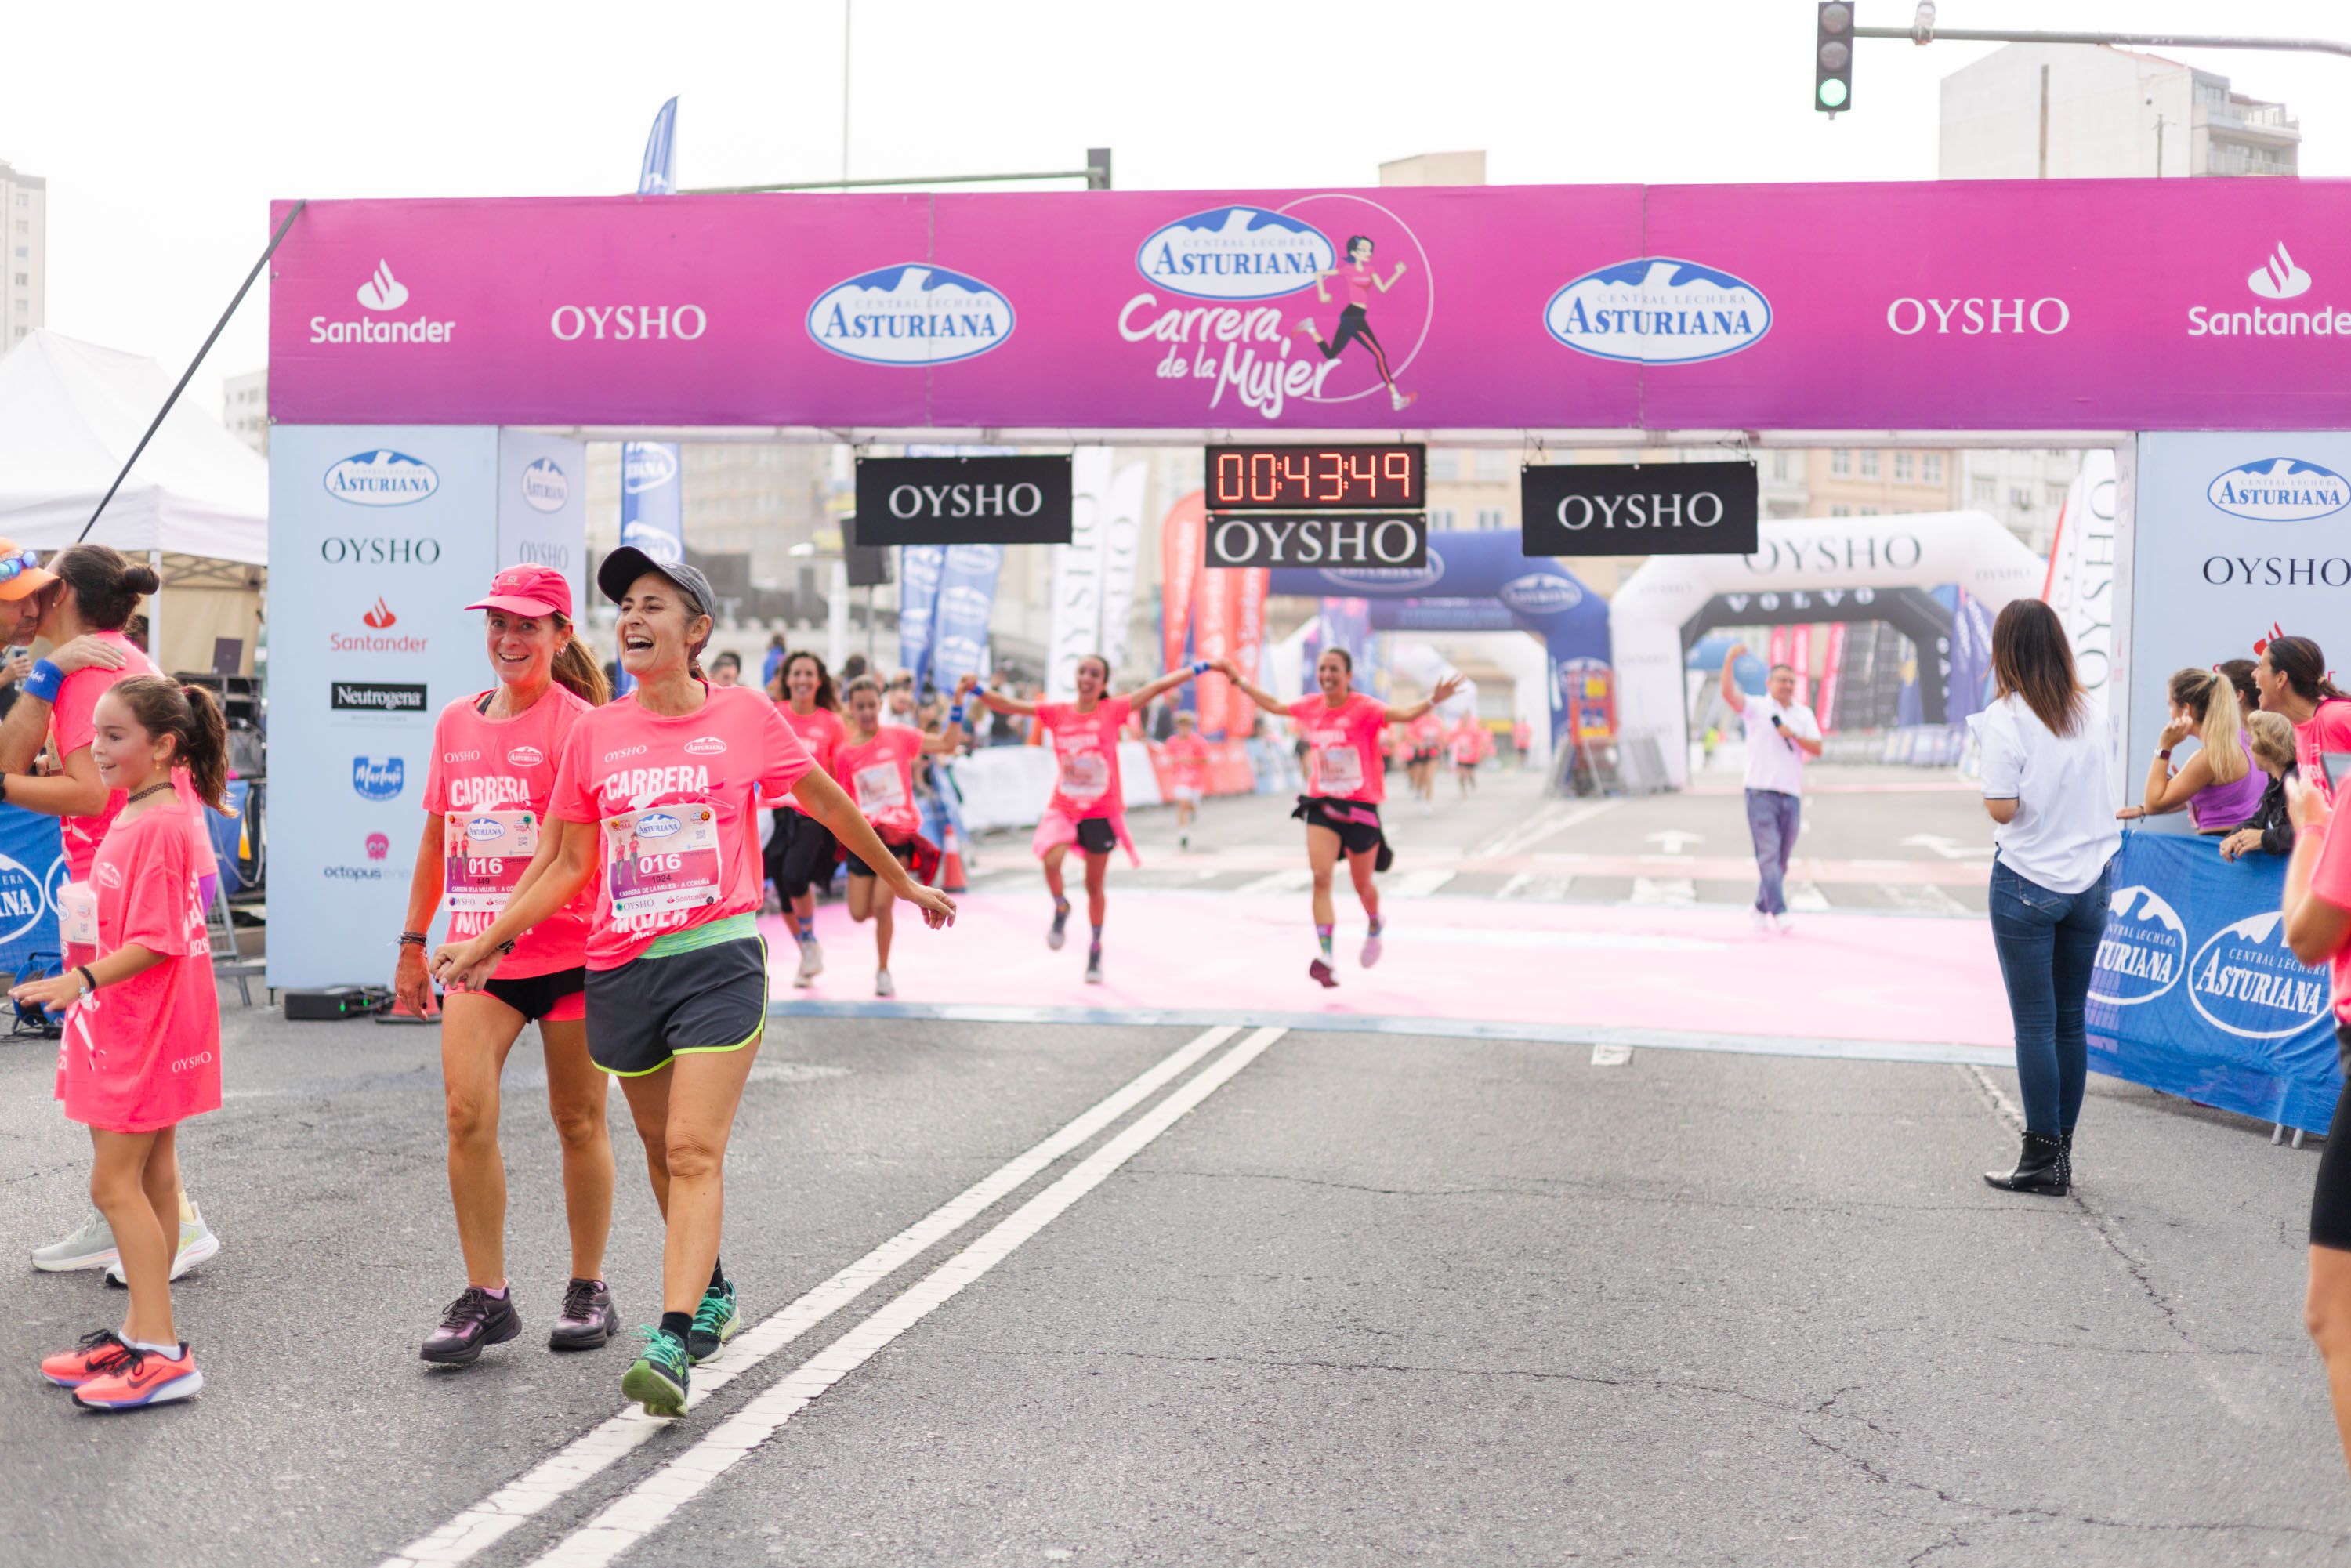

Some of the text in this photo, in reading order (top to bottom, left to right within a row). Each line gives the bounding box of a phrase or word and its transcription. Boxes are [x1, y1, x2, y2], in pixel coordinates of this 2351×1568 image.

[1183, 238, 1313, 248] CENTRAL LECHERA
[1153, 242, 1319, 275] ASTURIANA
[855, 298, 991, 309] CENTRAL LECHERA
[1597, 294, 1747, 305] CENTRAL LECHERA
[551, 305, 707, 341] OYSHO
[824, 302, 997, 338] ASTURIANA
[1118, 293, 1282, 342] Carrera
[1563, 297, 1754, 335] ASTURIANA
[1886, 296, 2070, 335] OYSHO
[2187, 306, 2351, 336] Santande
[310, 316, 455, 343] Santander
[1156, 337, 1342, 419] de la Mujer
[333, 471, 430, 492] ASTURIANA
[1218, 453, 1411, 502] 00:43:49
[888, 483, 1043, 519] OYSHO
[2219, 480, 2342, 505] ASTURIANA
[1557, 491, 1724, 531] OYSHO
[321, 537, 440, 565] OYSHO
[1214, 520, 1418, 563] OYSHO
[1743, 534, 1922, 574] OYSHO
[519, 541, 569, 570] OYSHO
[2203, 556, 2351, 587] OYSHO
[1726, 587, 1875, 613] VOLVO
[330, 632, 429, 654] Santander
[337, 686, 422, 709] Neutrogena
[444, 750, 480, 763] OYSHO
[510, 753, 540, 762] ASTURIANA
[604, 744, 648, 762] OYSHO
[451, 776, 531, 807] CARRERA
[605, 765, 710, 801] CARRERA
[469, 827, 502, 835] ASTURIANA
[639, 824, 678, 835] ASTURIANA
[324, 866, 382, 882] octopus
[469, 857, 503, 875] 016
[640, 853, 682, 874] 016
[619, 887, 642, 897] CARRERA
[657, 882, 677, 892] MUJER
[652, 874, 672, 883] 1024
[624, 899, 654, 911] OYSHO
[676, 892, 708, 903] Santander
[190, 937, 210, 958] 026
[2136, 928, 2176, 947] LECHERA
[2229, 948, 2326, 977] CENTRAL LECHERA
[2195, 947, 2322, 1016] ASTURIANA
[172, 1051, 212, 1073] OYSHO
